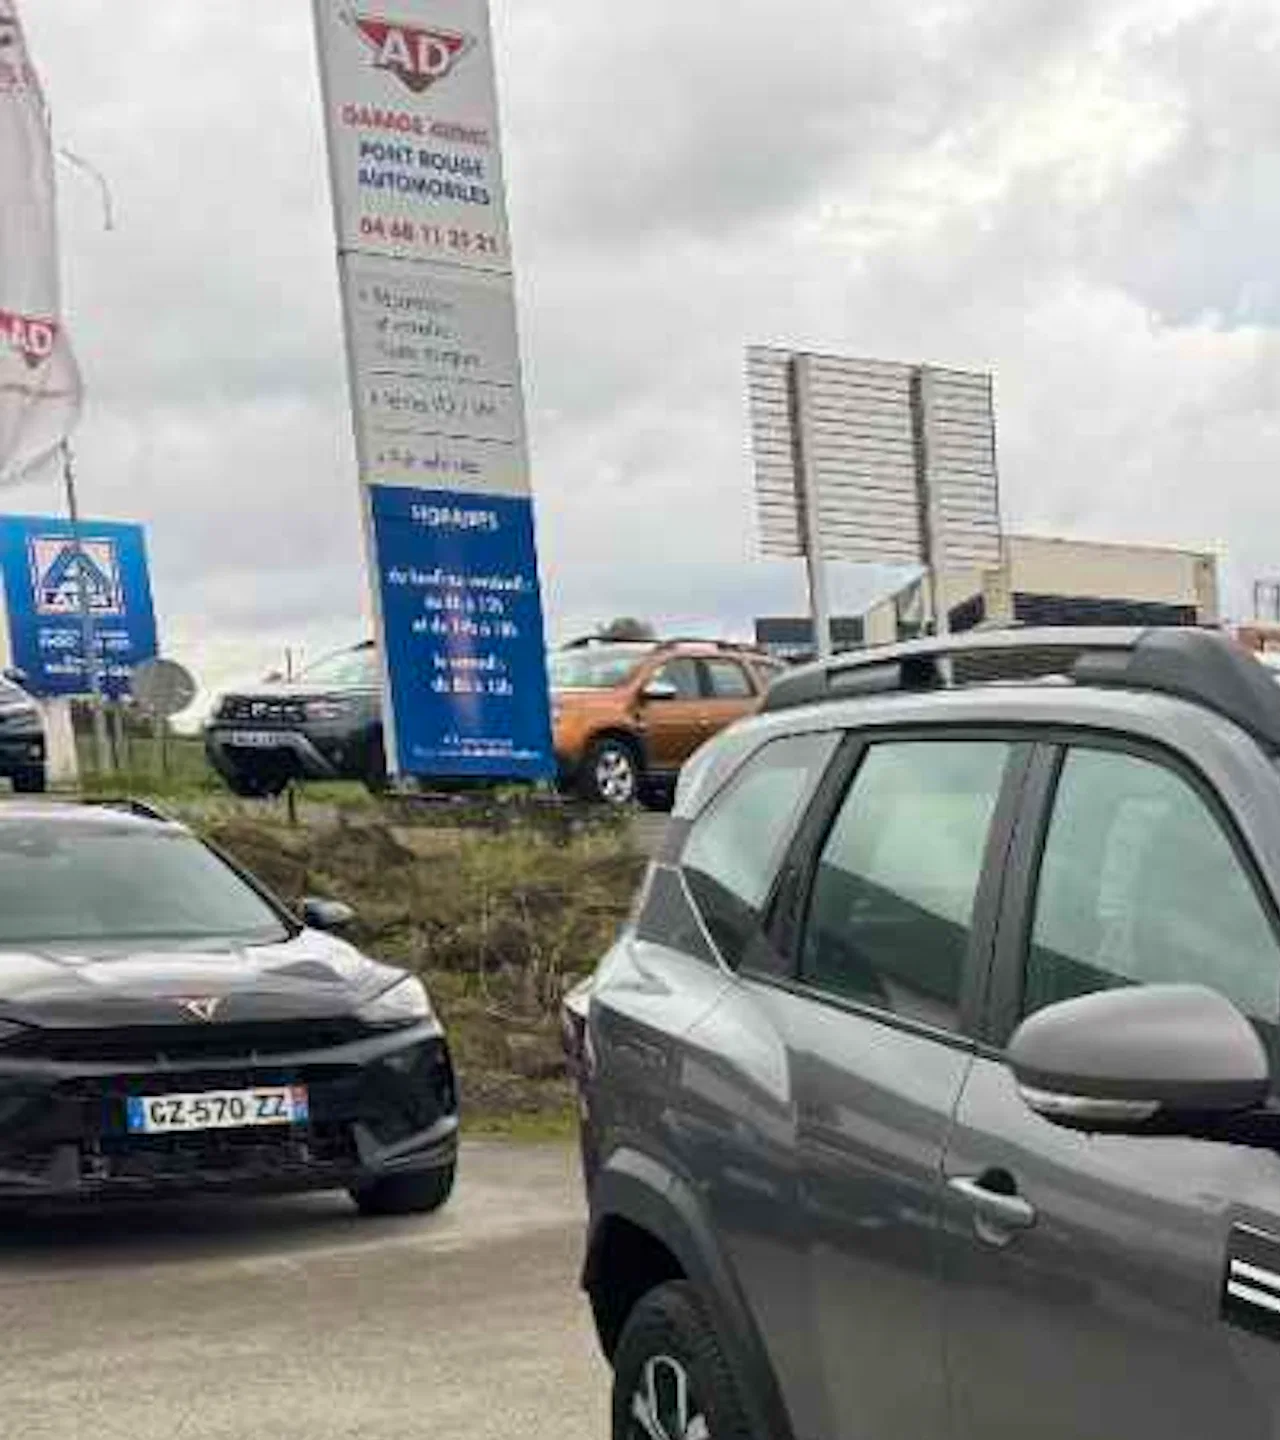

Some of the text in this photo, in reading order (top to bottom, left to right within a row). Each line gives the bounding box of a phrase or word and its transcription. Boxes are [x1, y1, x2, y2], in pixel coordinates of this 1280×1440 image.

[381, 25, 451, 76] AD
[359, 141, 485, 178] PONT ROUGE
[358, 168, 490, 206] AUTOMOBILES
[410, 503, 498, 531] HORAIRES
